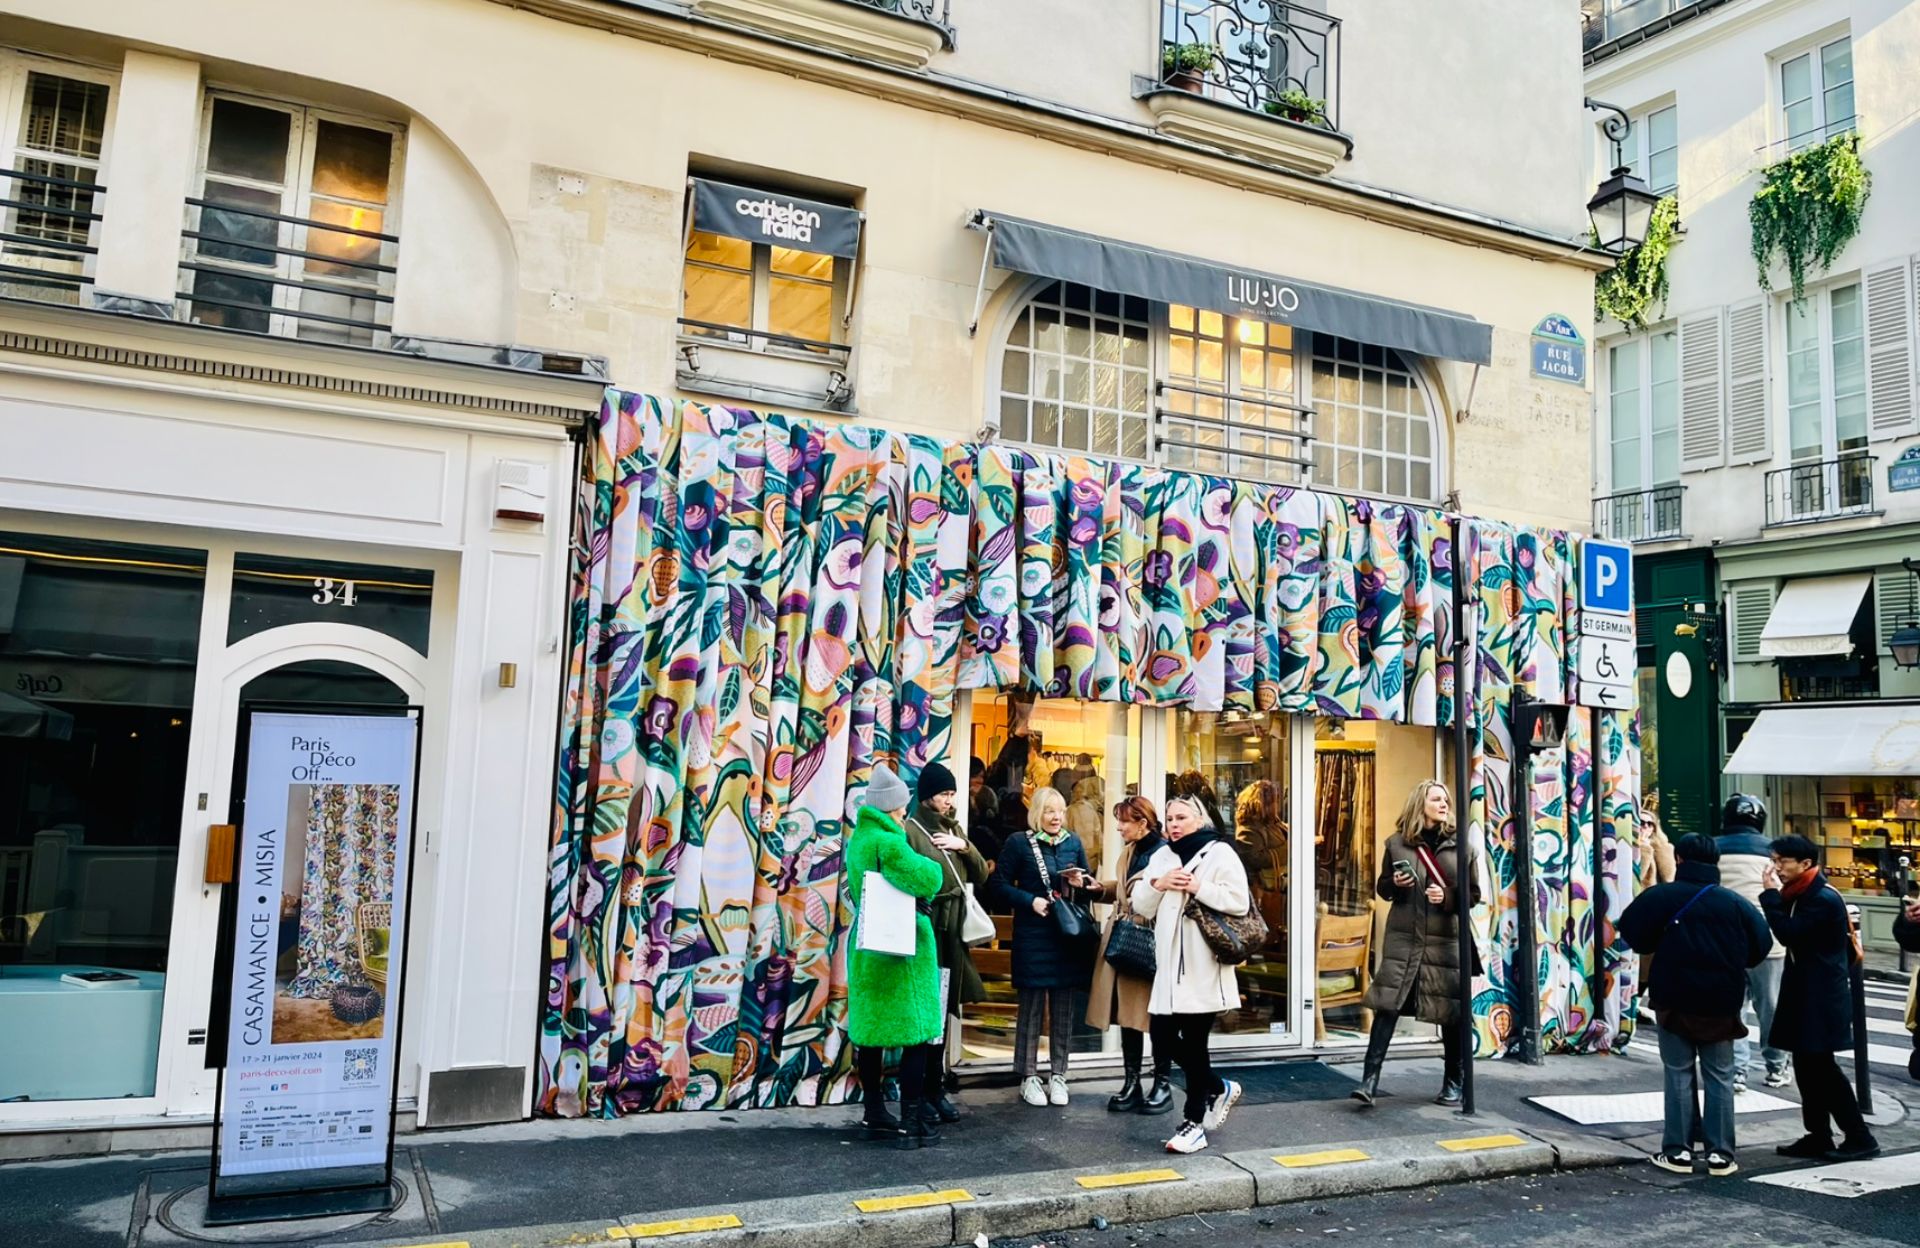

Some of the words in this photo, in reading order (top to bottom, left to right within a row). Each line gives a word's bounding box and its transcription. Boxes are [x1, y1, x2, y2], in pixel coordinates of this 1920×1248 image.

[735, 198, 821, 229] cattelan
[761, 217, 812, 243] italia
[1547, 346, 1569, 361] RUE
[1596, 554, 1618, 598] P
[312, 577, 358, 607] 34
[1583, 618, 1594, 630] ST
[1595, 620, 1632, 635] GERMAIN
[291, 736, 331, 751] Paris
[310, 751, 356, 767] Déco
[255, 828, 277, 887] MISIA
[243, 912, 271, 1046] CASAMANCE
[242, 1055, 252, 1064] 17
[261, 1054, 272, 1063] 21
[273, 1052, 301, 1064] janvier
[302, 1051, 323, 1060] 2024
